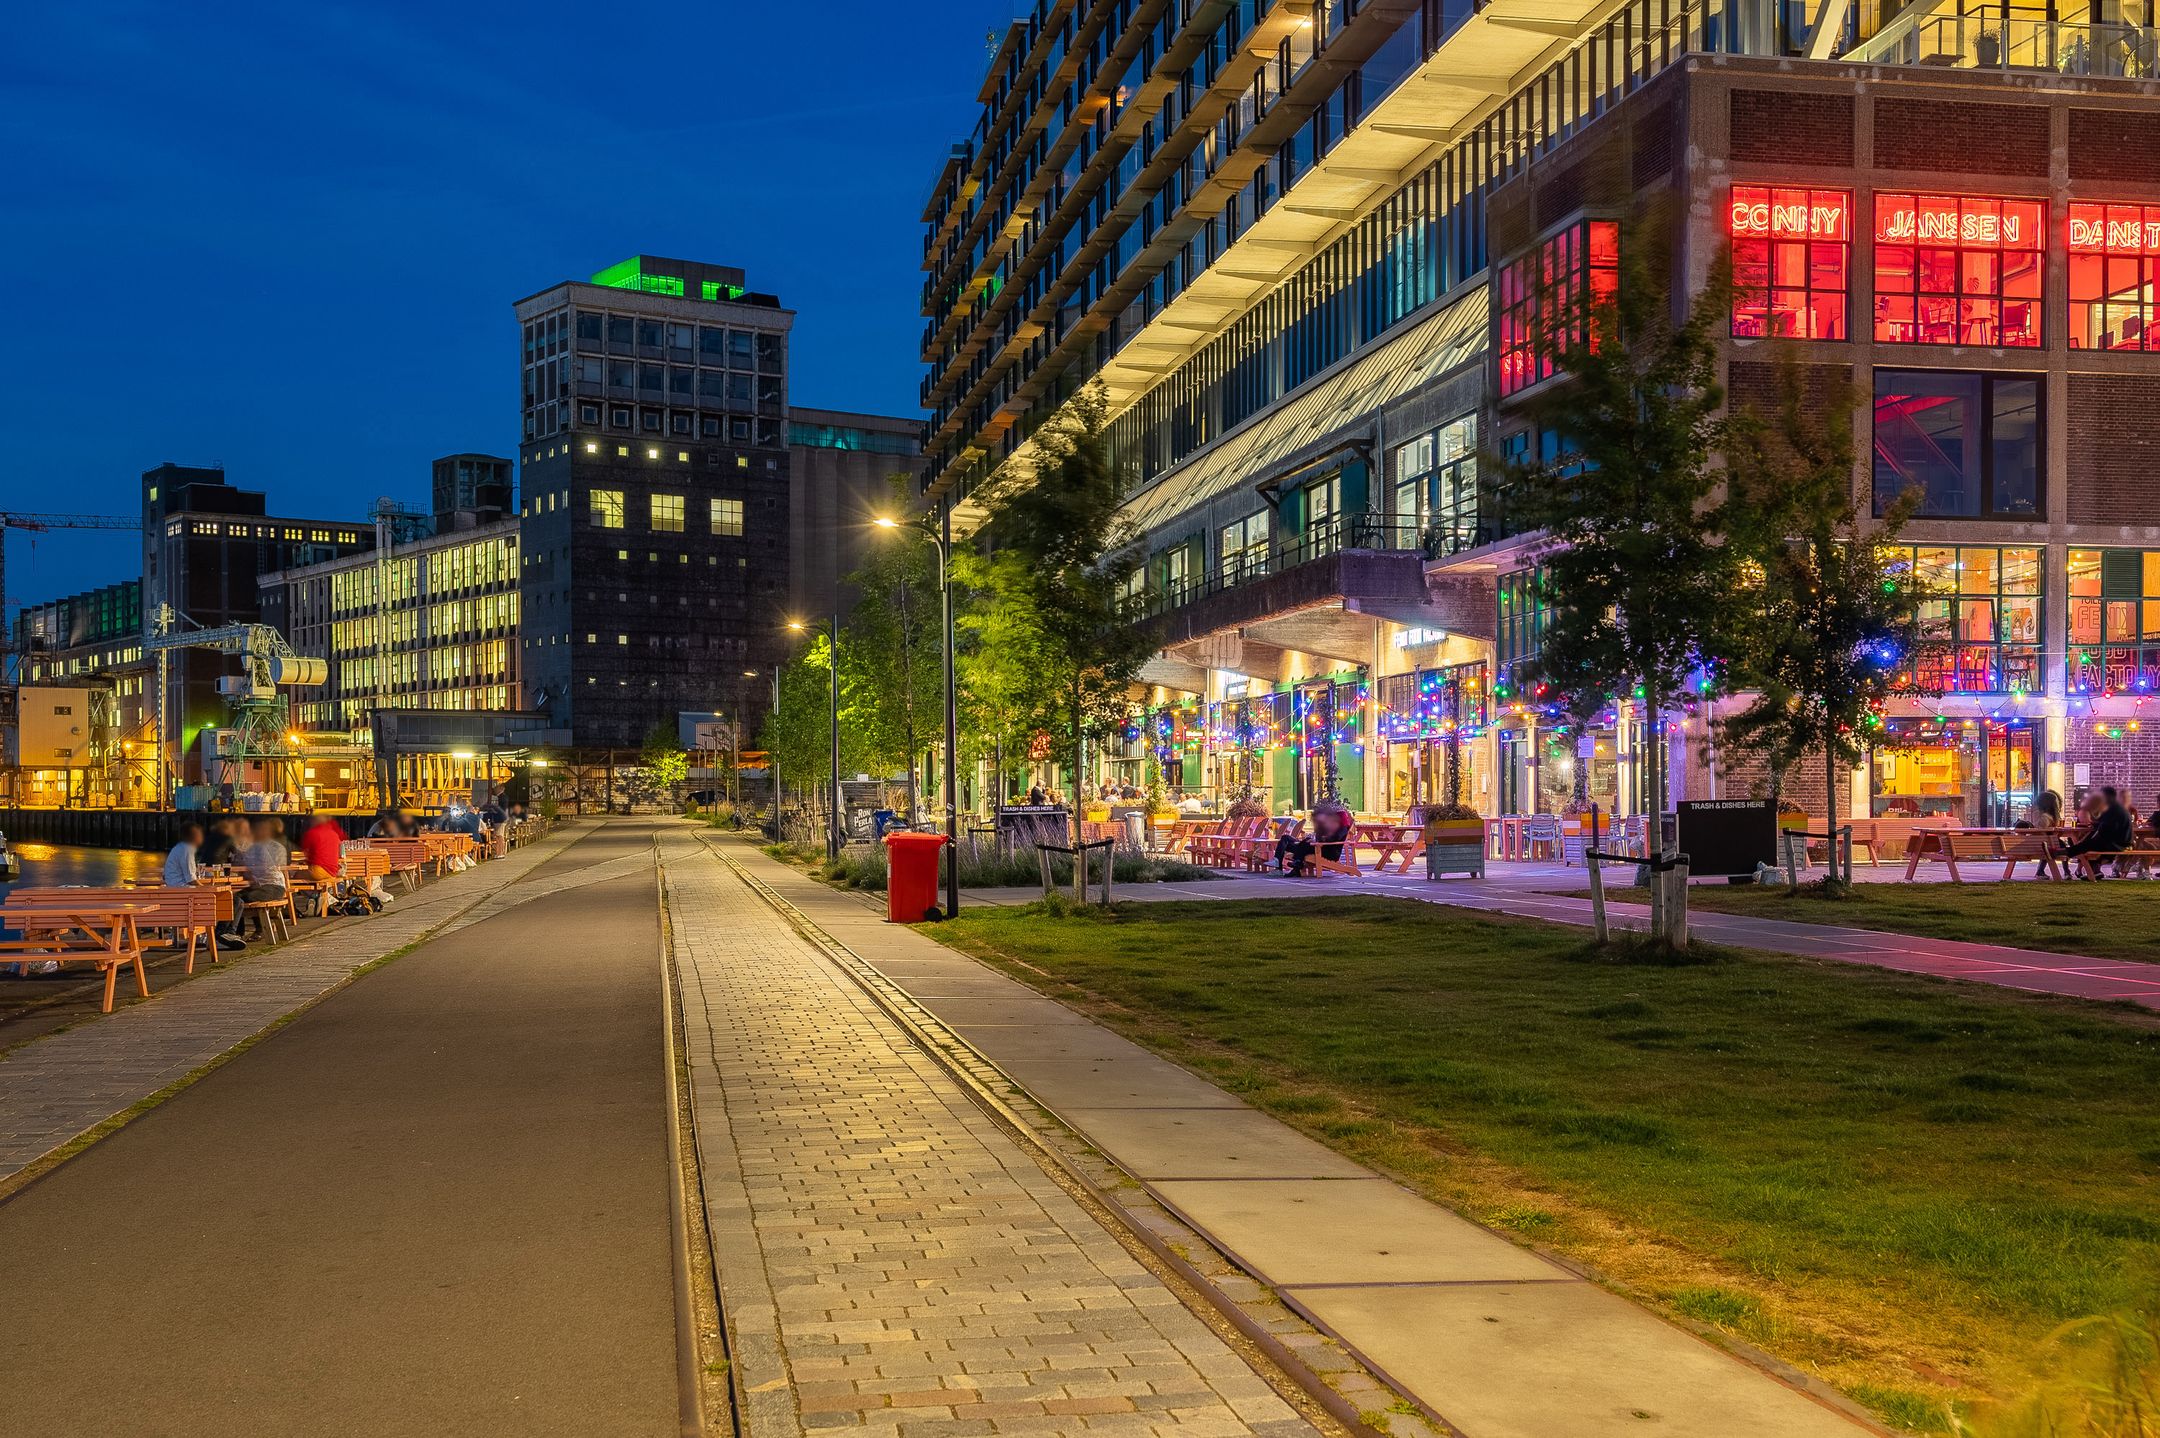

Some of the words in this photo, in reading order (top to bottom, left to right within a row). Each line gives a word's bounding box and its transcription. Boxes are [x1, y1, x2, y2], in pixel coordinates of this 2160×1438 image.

[1732, 203, 1840, 234] CONNY
[1886, 211, 2019, 242] JANSSEN
[1691, 802, 1713, 810] TRASH
[1721, 801, 1746, 809] DISHES
[858, 808, 871, 819] RON
[854, 816, 873, 828] PERLA
